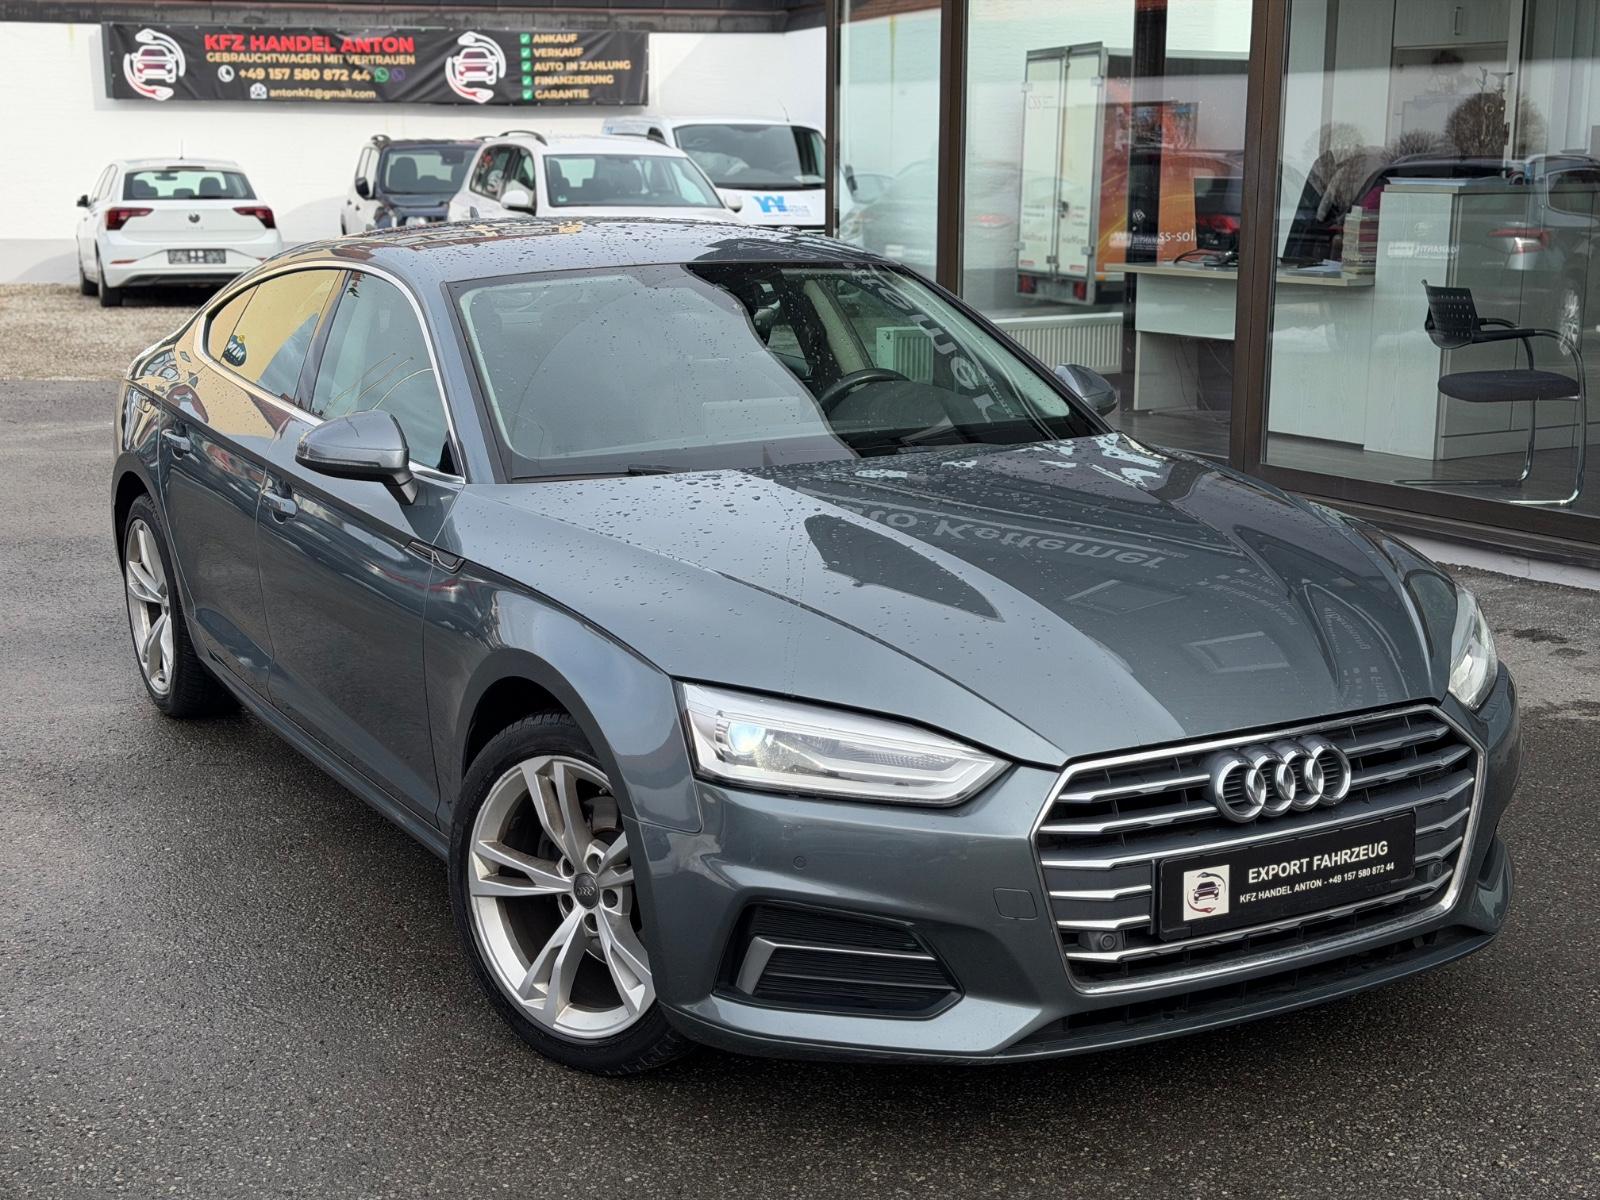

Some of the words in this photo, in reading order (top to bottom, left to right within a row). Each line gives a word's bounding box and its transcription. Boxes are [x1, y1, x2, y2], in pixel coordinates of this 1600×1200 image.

[204, 34, 245, 51] KFZ
[250, 35, 336, 52] HANDEL
[340, 36, 415, 53] ANTON
[532, 33, 578, 43] ANKAUF
[533, 47, 584, 57] VERKAUF
[206, 52, 322, 64] GEBRAUCHTWAGEN
[323, 54, 345, 64] MIT
[346, 54, 415, 65] VERTRAUEN
[534, 61, 564, 71] AUTO
[566, 61, 578, 71] IN
[580, 60, 632, 71] ZAHLUNG
[238, 67, 265, 80] +49
[268, 68, 290, 80] 157
[294, 68, 320, 80] 580
[323, 69, 349, 81] 872
[351, 69, 371, 81] 44
[534, 74, 614, 86] FINANZIERUNG
[269, 88, 376, 100] antonkfz@gmail.com
[535, 89, 590, 99] GARANTIE
[1248, 857, 1310, 884] EXPORT
[1312, 840, 1388, 871] FAHRZEUG
[1239, 892, 1257, 903] KFZ
[1258, 885, 1292, 900] HANDEL
[1293, 879, 1322, 893] ANTON
[1328, 874, 1342, 884] +49
[1344, 871, 1357, 881] 157
[1358, 867, 1371, 878] 580
[1372, 864, 1385, 875] 872
[1385, 861, 1395, 871] 44
